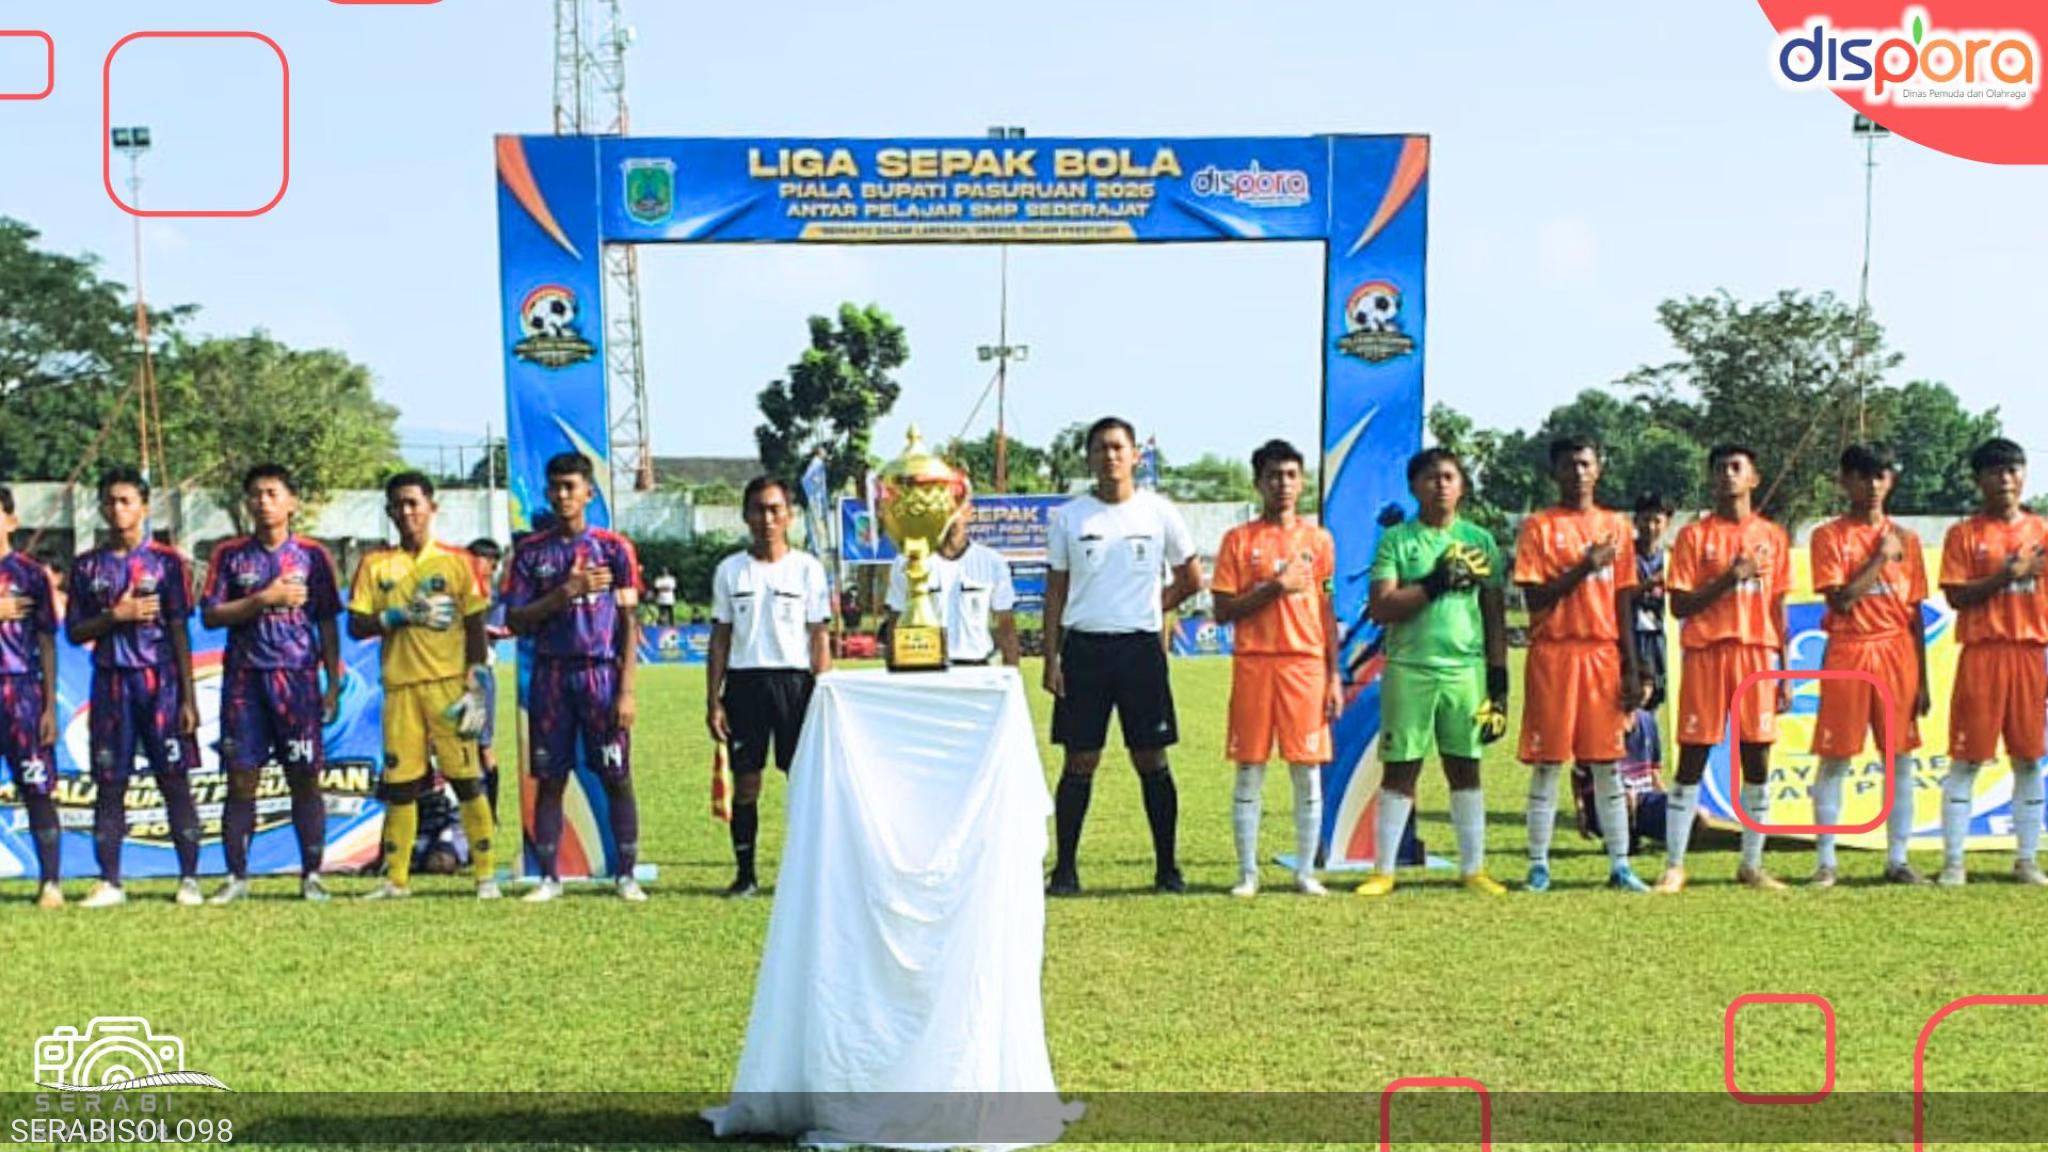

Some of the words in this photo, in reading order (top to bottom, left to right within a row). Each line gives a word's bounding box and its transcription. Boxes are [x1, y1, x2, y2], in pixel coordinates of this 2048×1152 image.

[749, 148, 858, 178] LIGA
[876, 148, 1037, 178] SEPAK
[1053, 148, 1183, 178] BOLA
[779, 181, 853, 199] PIALA
[861, 181, 947, 199] BUPATI
[954, 181, 1087, 199] PASURUAN
[786, 202, 858, 217] ANTAR
[864, 202, 962, 217] PELAJAR
[970, 202, 1018, 217] SMP
[1025, 201, 1150, 217] SEDERAJAT
[165, 739, 182, 763] 3
[287, 738, 314, 764] 34
[21, 759, 48, 784] 22
